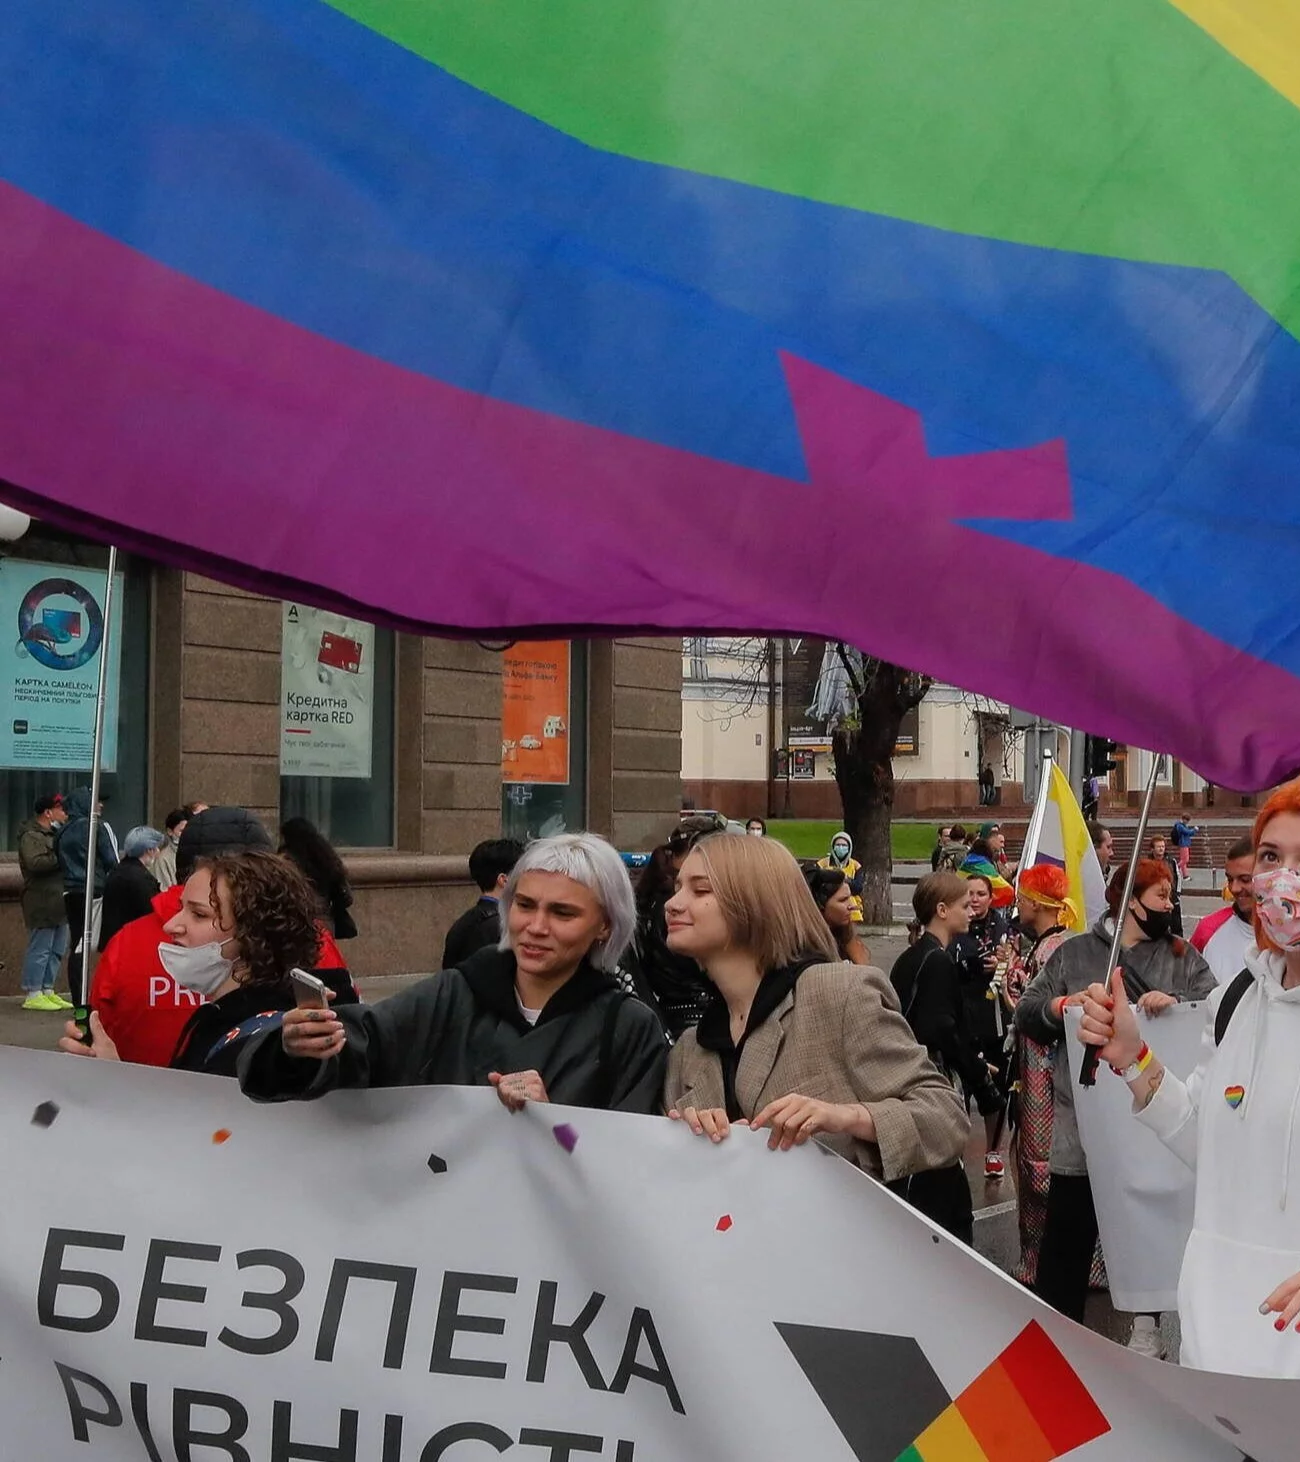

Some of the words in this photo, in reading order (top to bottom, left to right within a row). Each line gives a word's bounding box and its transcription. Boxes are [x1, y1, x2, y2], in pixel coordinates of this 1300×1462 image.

[15, 678, 49, 688] КАРТКА
[14, 695, 39, 703] ПЕРІОД
[287, 692, 348, 709] Кредитна
[286, 711, 329, 724] картка
[332, 711, 354, 725] RED
[37, 1227, 686, 1415] БЕЗПЕКА
